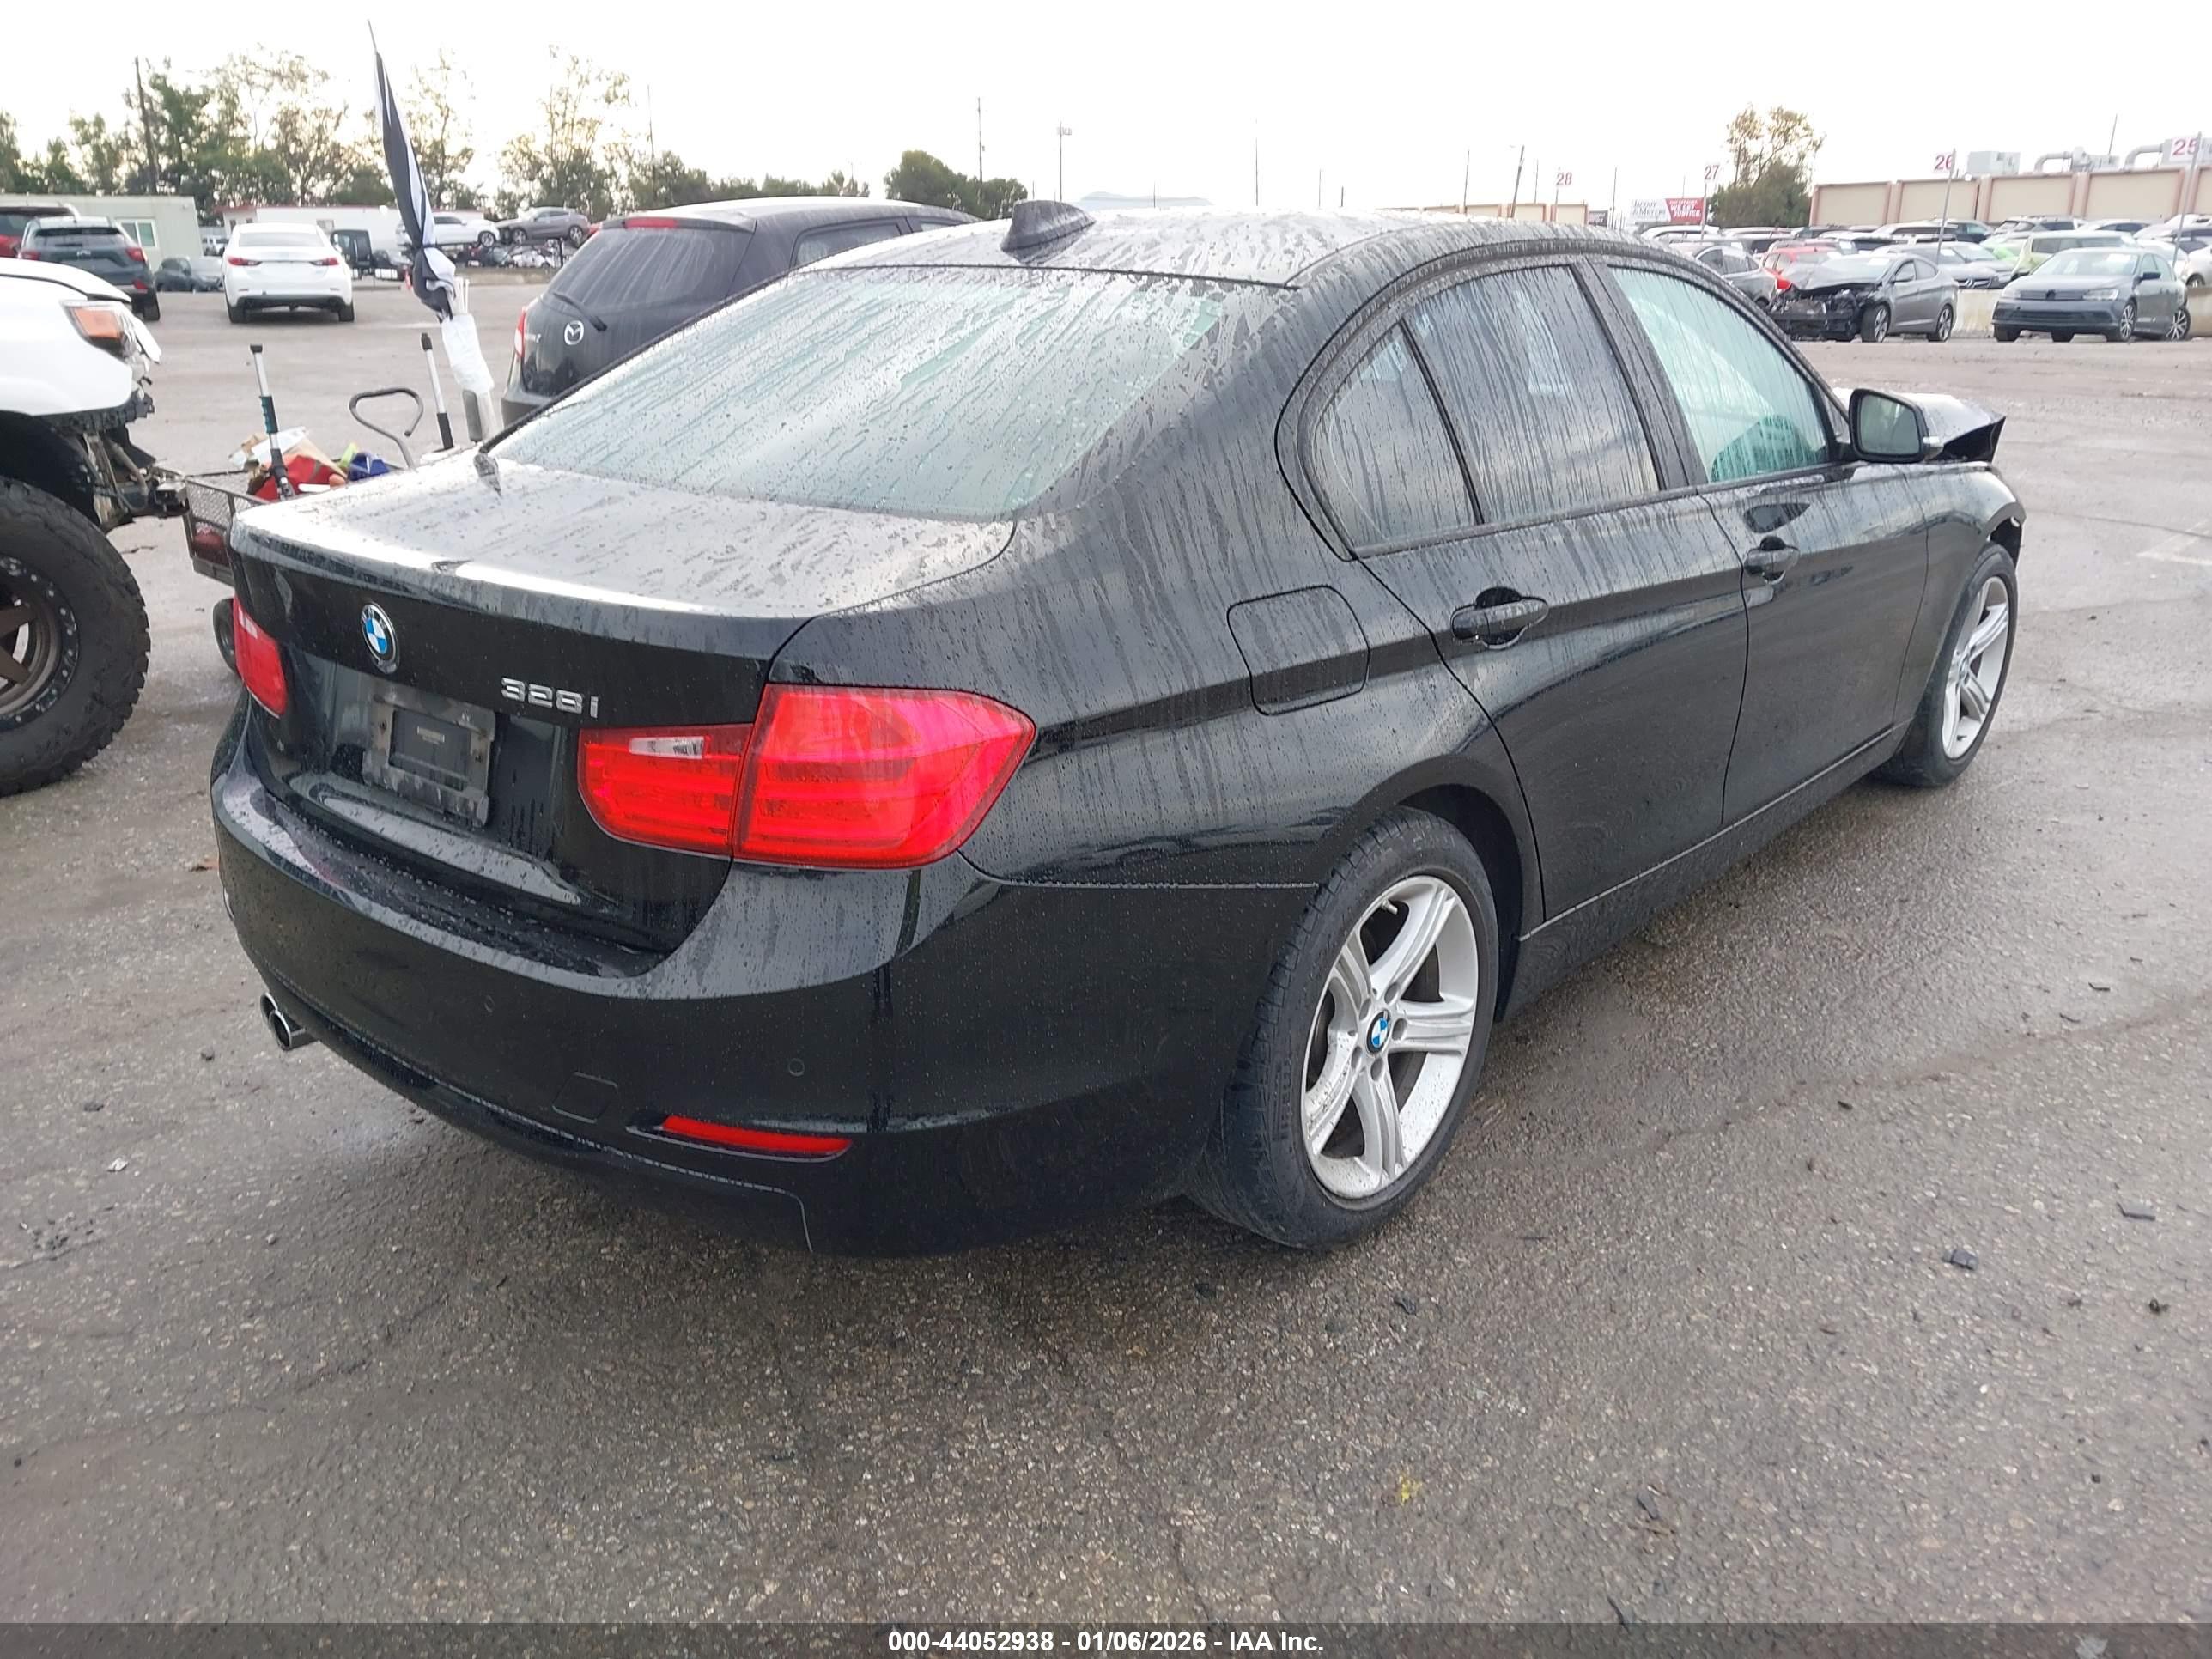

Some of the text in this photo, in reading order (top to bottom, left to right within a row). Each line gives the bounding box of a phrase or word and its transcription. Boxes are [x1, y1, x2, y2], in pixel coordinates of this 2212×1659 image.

[2172, 139, 2197, 155] 25
[1935, 155, 1954, 170] 26
[1556, 172, 1572, 185] 28
[1705, 165, 1720, 179] 27
[501, 677, 599, 718] 328i
